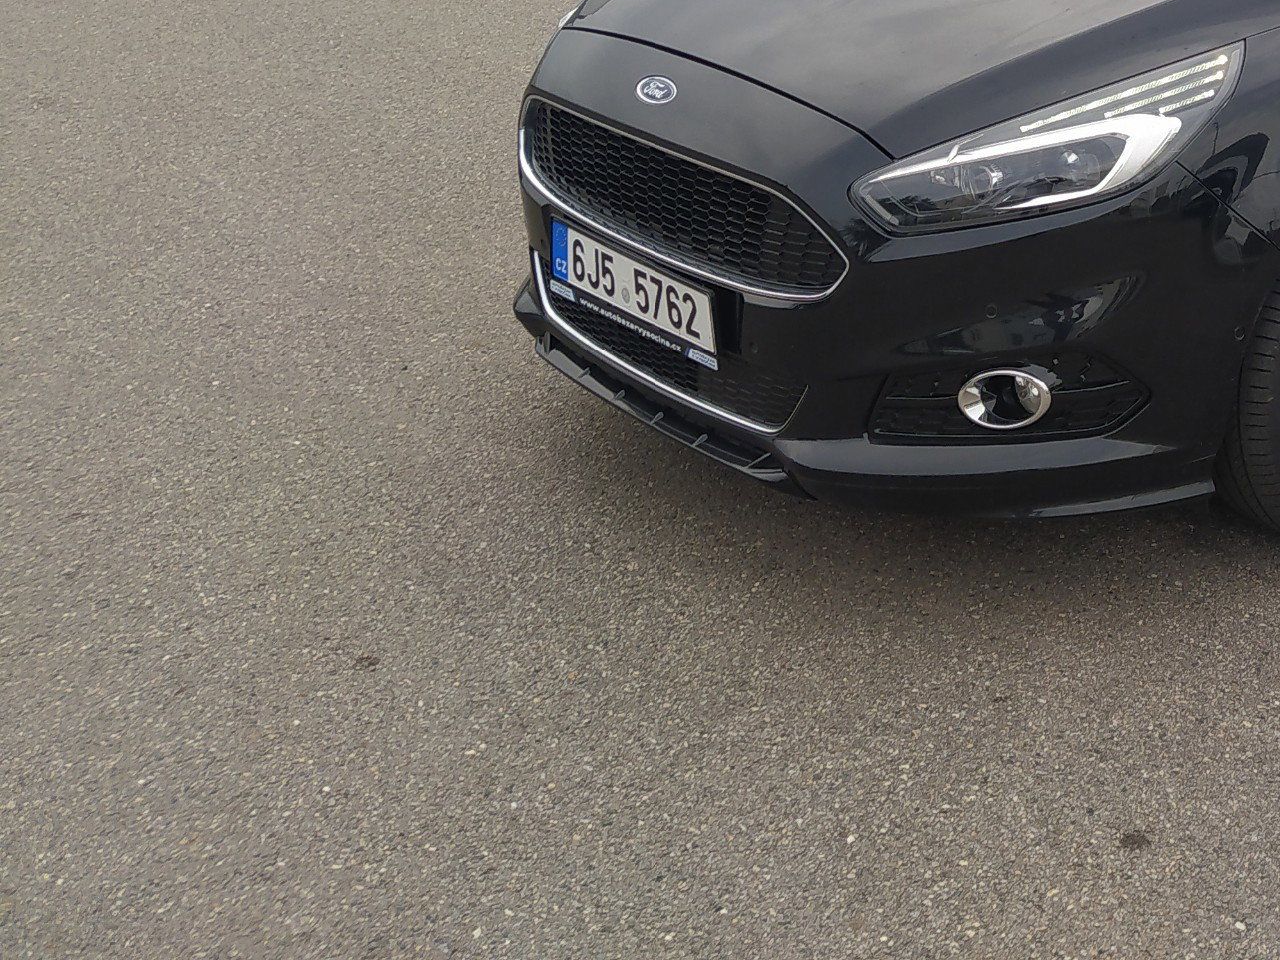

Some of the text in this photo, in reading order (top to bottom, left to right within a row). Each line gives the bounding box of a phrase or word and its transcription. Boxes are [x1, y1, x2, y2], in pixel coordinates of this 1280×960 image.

[555, 238, 701, 340] CZ 6J5 5762
